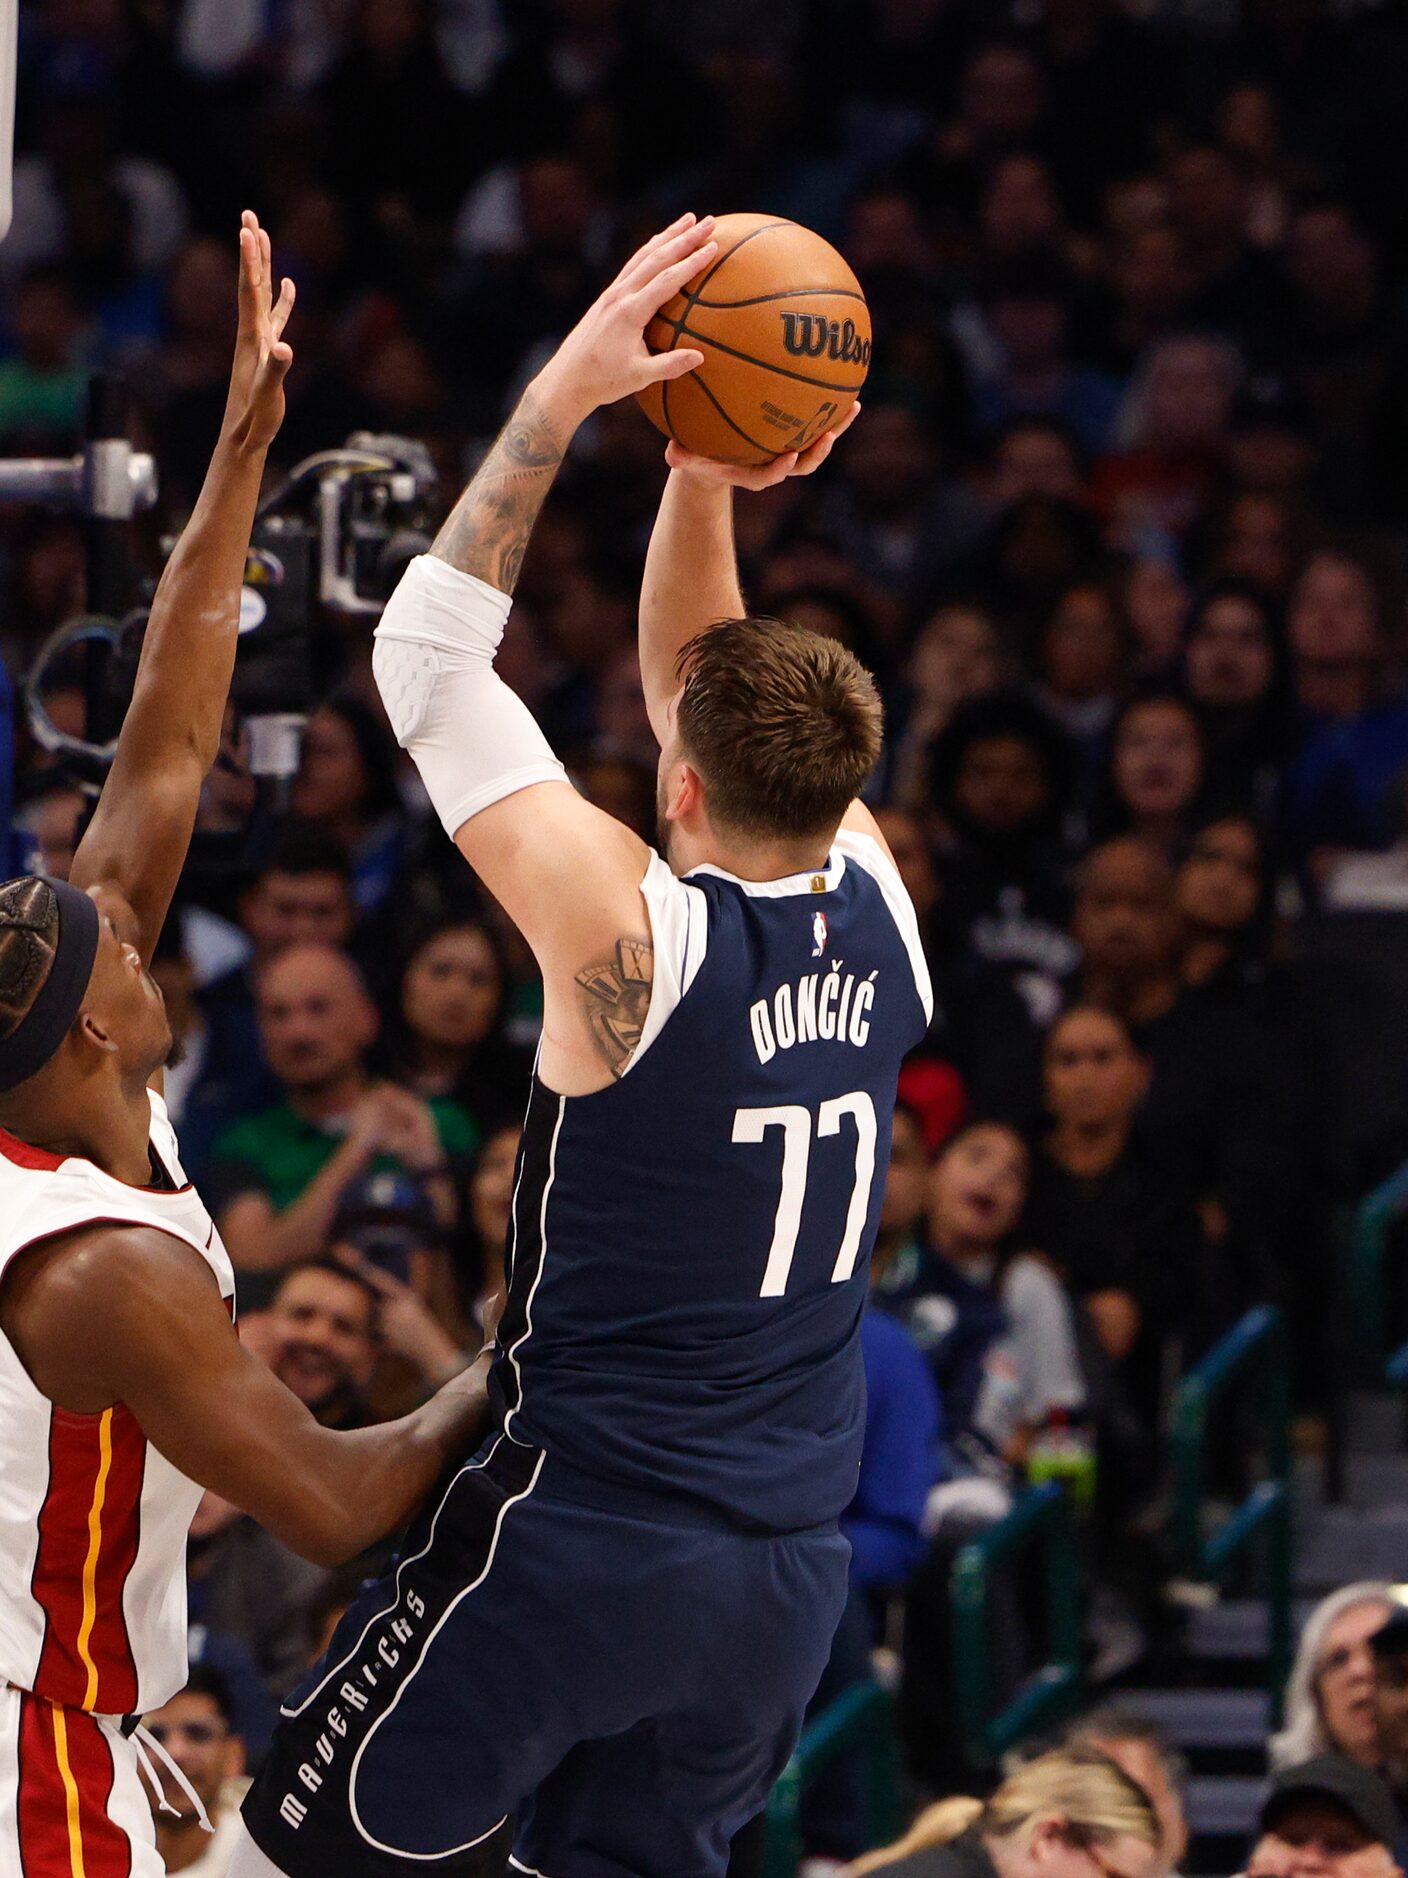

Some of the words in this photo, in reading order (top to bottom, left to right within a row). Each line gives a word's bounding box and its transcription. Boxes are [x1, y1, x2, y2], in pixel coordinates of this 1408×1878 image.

[749, 959, 880, 1065] DONČIĆ
[731, 1091, 878, 1298] 77
[279, 1588, 426, 1831] MAVERICKS
